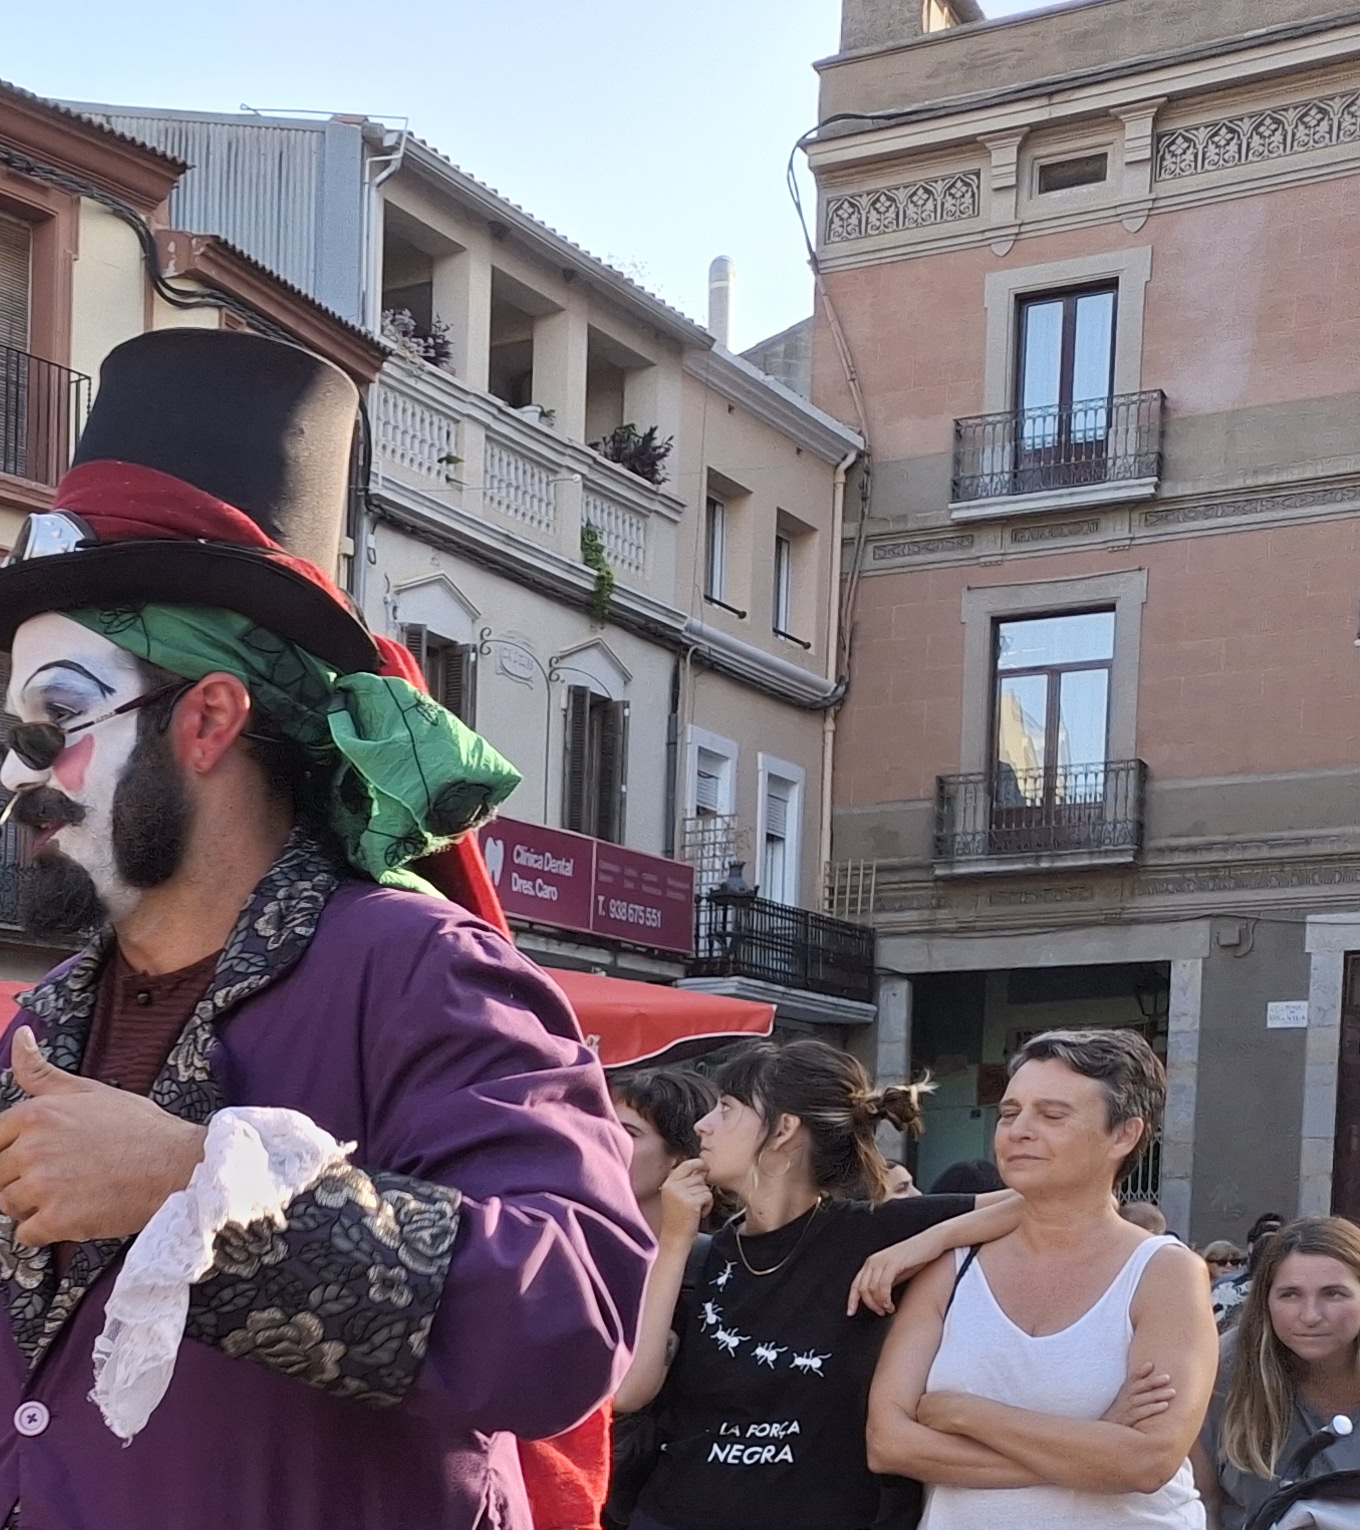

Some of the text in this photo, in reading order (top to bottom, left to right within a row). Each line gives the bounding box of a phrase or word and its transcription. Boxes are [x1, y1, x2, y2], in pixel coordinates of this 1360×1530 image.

[543, 851, 575, 877] Dental
[535, 878, 559, 902] Caro
[720, 1420, 800, 1440] LA FORÇA
[707, 1442, 794, 1465] NEGRA
